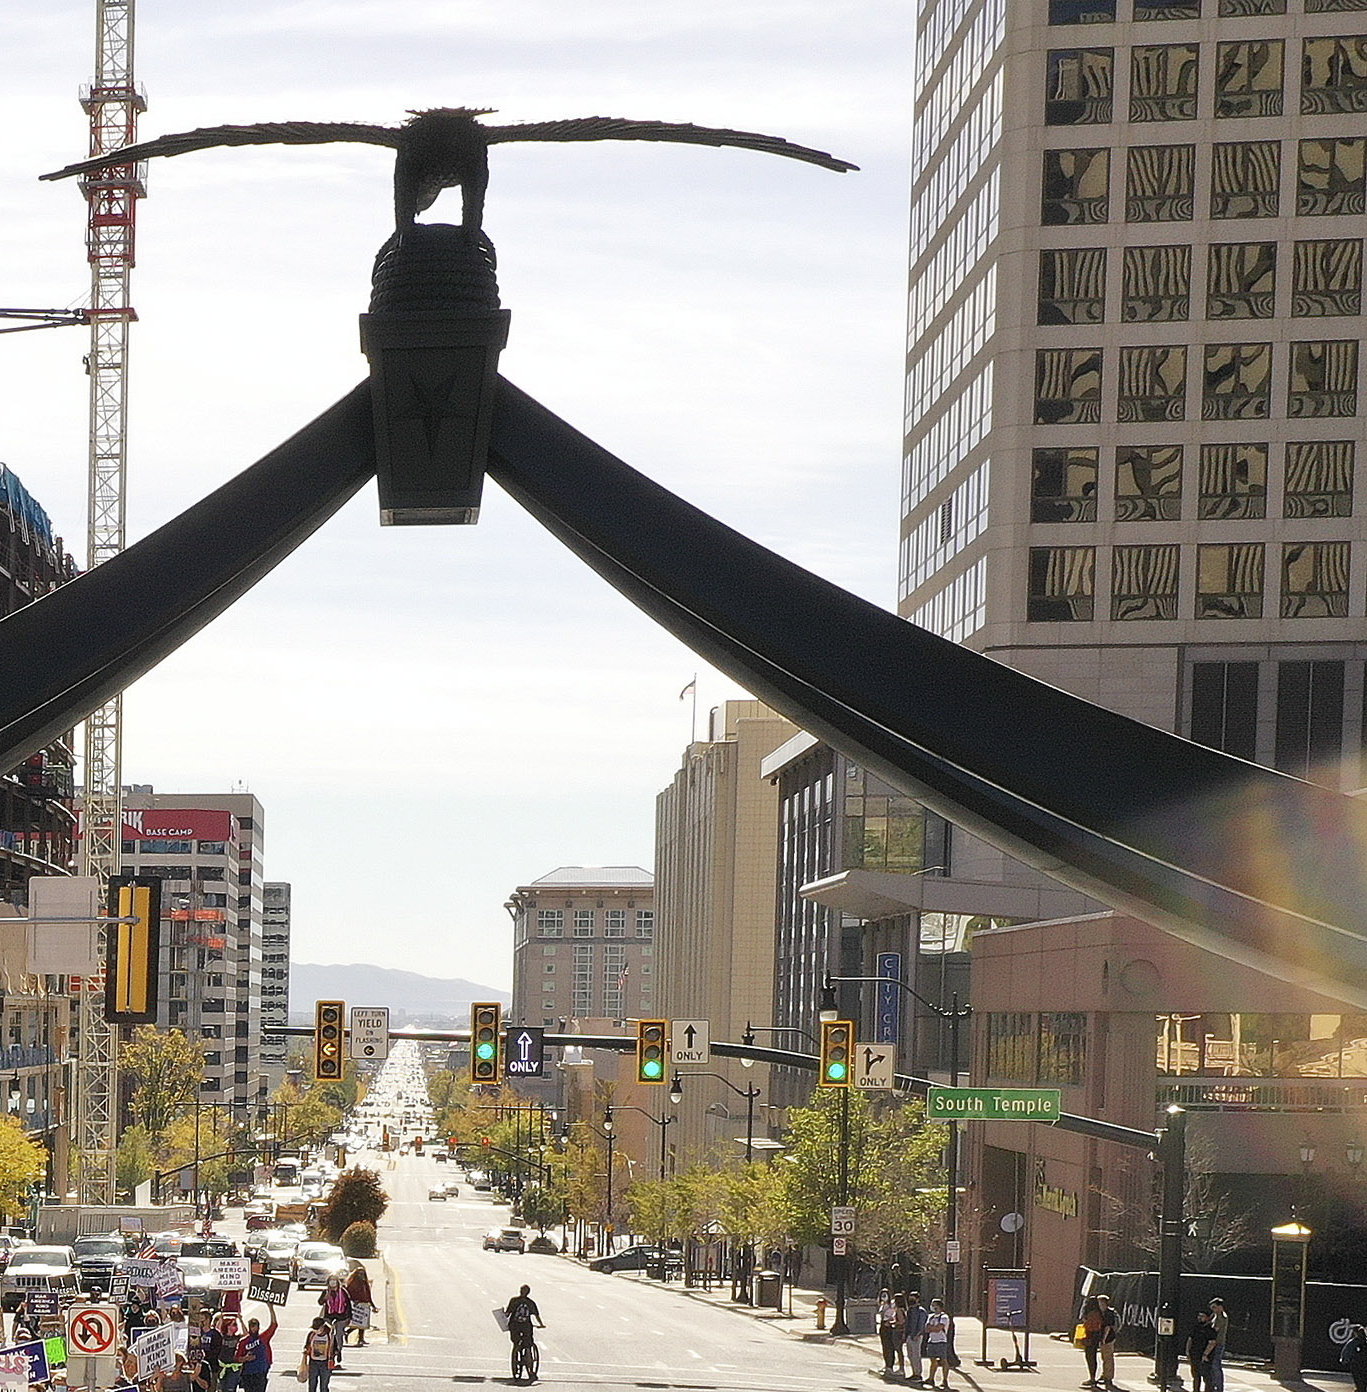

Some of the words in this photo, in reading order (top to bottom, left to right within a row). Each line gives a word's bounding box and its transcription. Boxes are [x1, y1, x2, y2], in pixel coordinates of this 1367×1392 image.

[358, 1019, 381, 1028] YIELD
[677, 1052, 703, 1060] ONLY
[510, 1062, 538, 1072] ONLY
[860, 1078, 886, 1087] ONLY
[936, 1097, 982, 1111] South
[993, 1097, 1051, 1114] Temple
[834, 1221, 852, 1231] 30
[250, 1288, 284, 1304] Dissent
